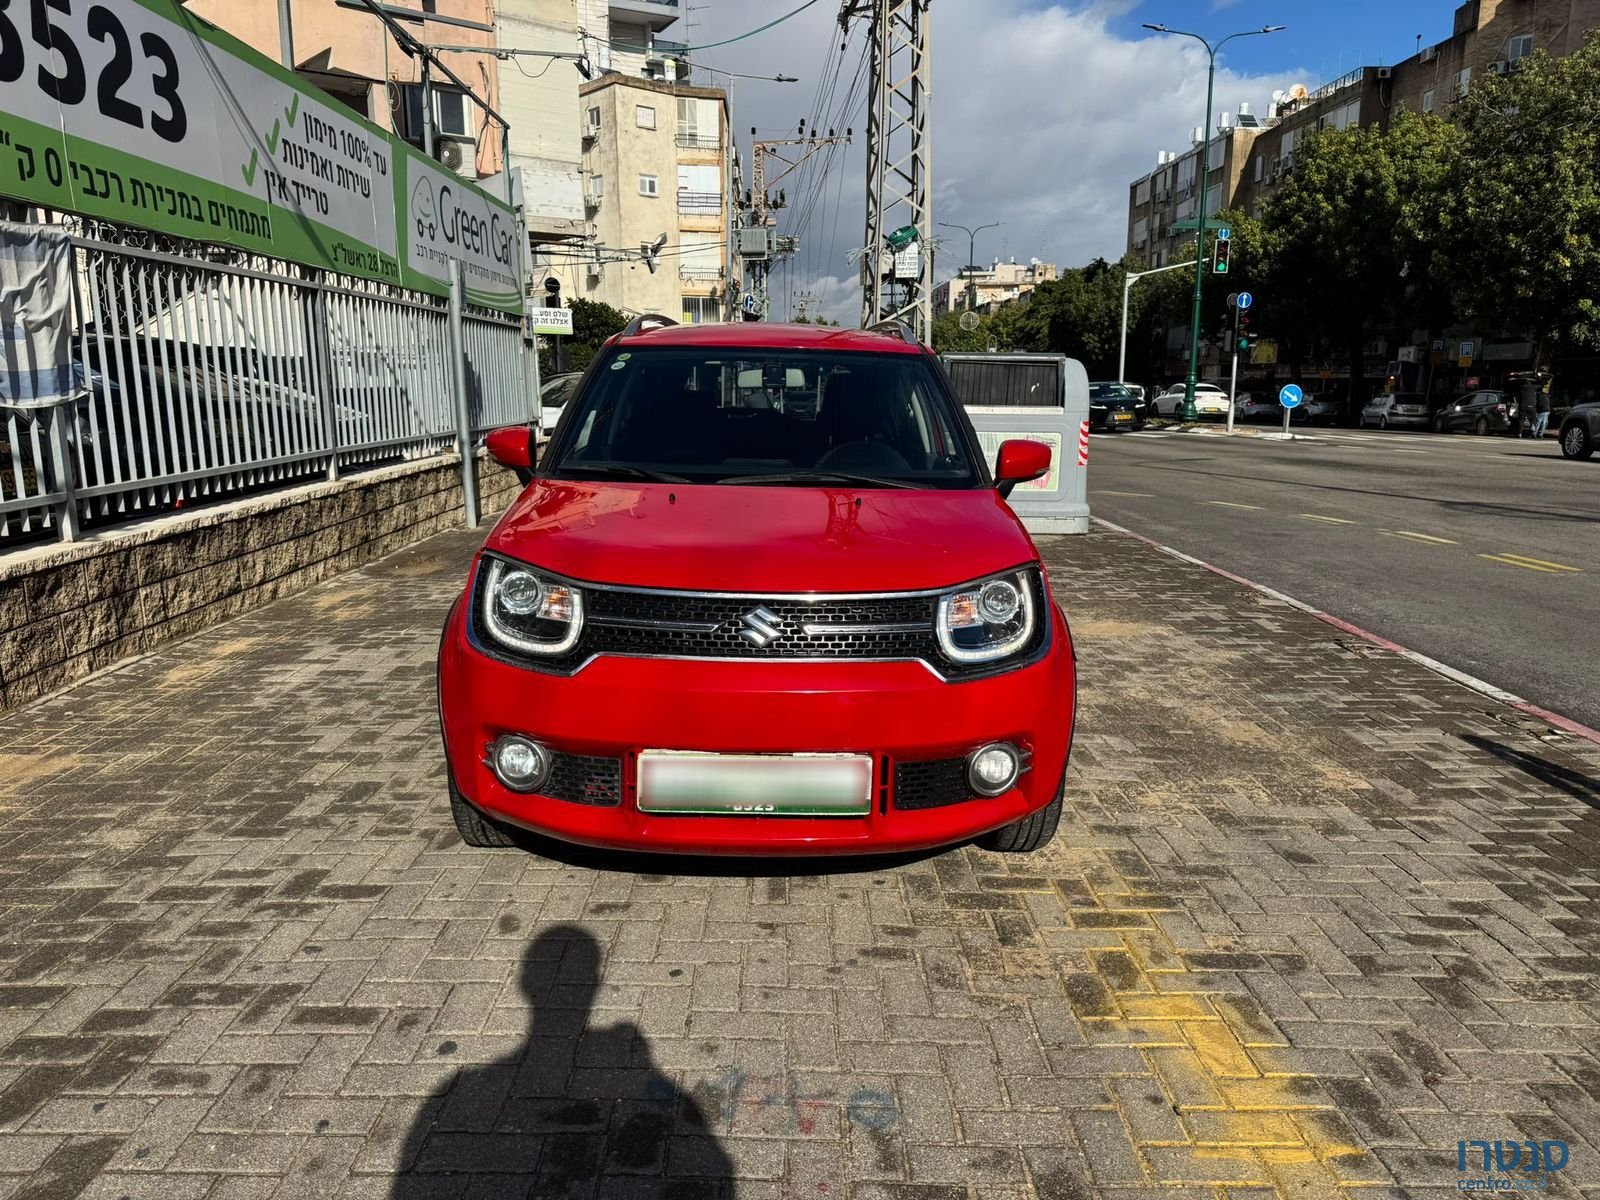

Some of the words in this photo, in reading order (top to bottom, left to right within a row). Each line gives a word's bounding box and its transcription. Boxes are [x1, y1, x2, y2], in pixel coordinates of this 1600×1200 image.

[303, 111, 337, 151] מימון
[340, 129, 372, 168] 100%
[44, 147, 63, 188] 0
[281, 138, 334, 183] ואמינות
[373, 150, 386, 176] עד
[69, 161, 125, 203] רכבי
[129, 178, 205, 223] במכירת
[264, 169, 289, 204] אין
[291, 180, 329, 215] טרייד
[336, 164, 371, 199] שירות
[207, 199, 272, 240] מתמחים
[439, 185, 490, 259] Green
[491, 213, 513, 267] Car
[367, 252, 379, 273] 28
[379, 254, 399, 278] הרצל
[415, 243, 429, 258] רכב
